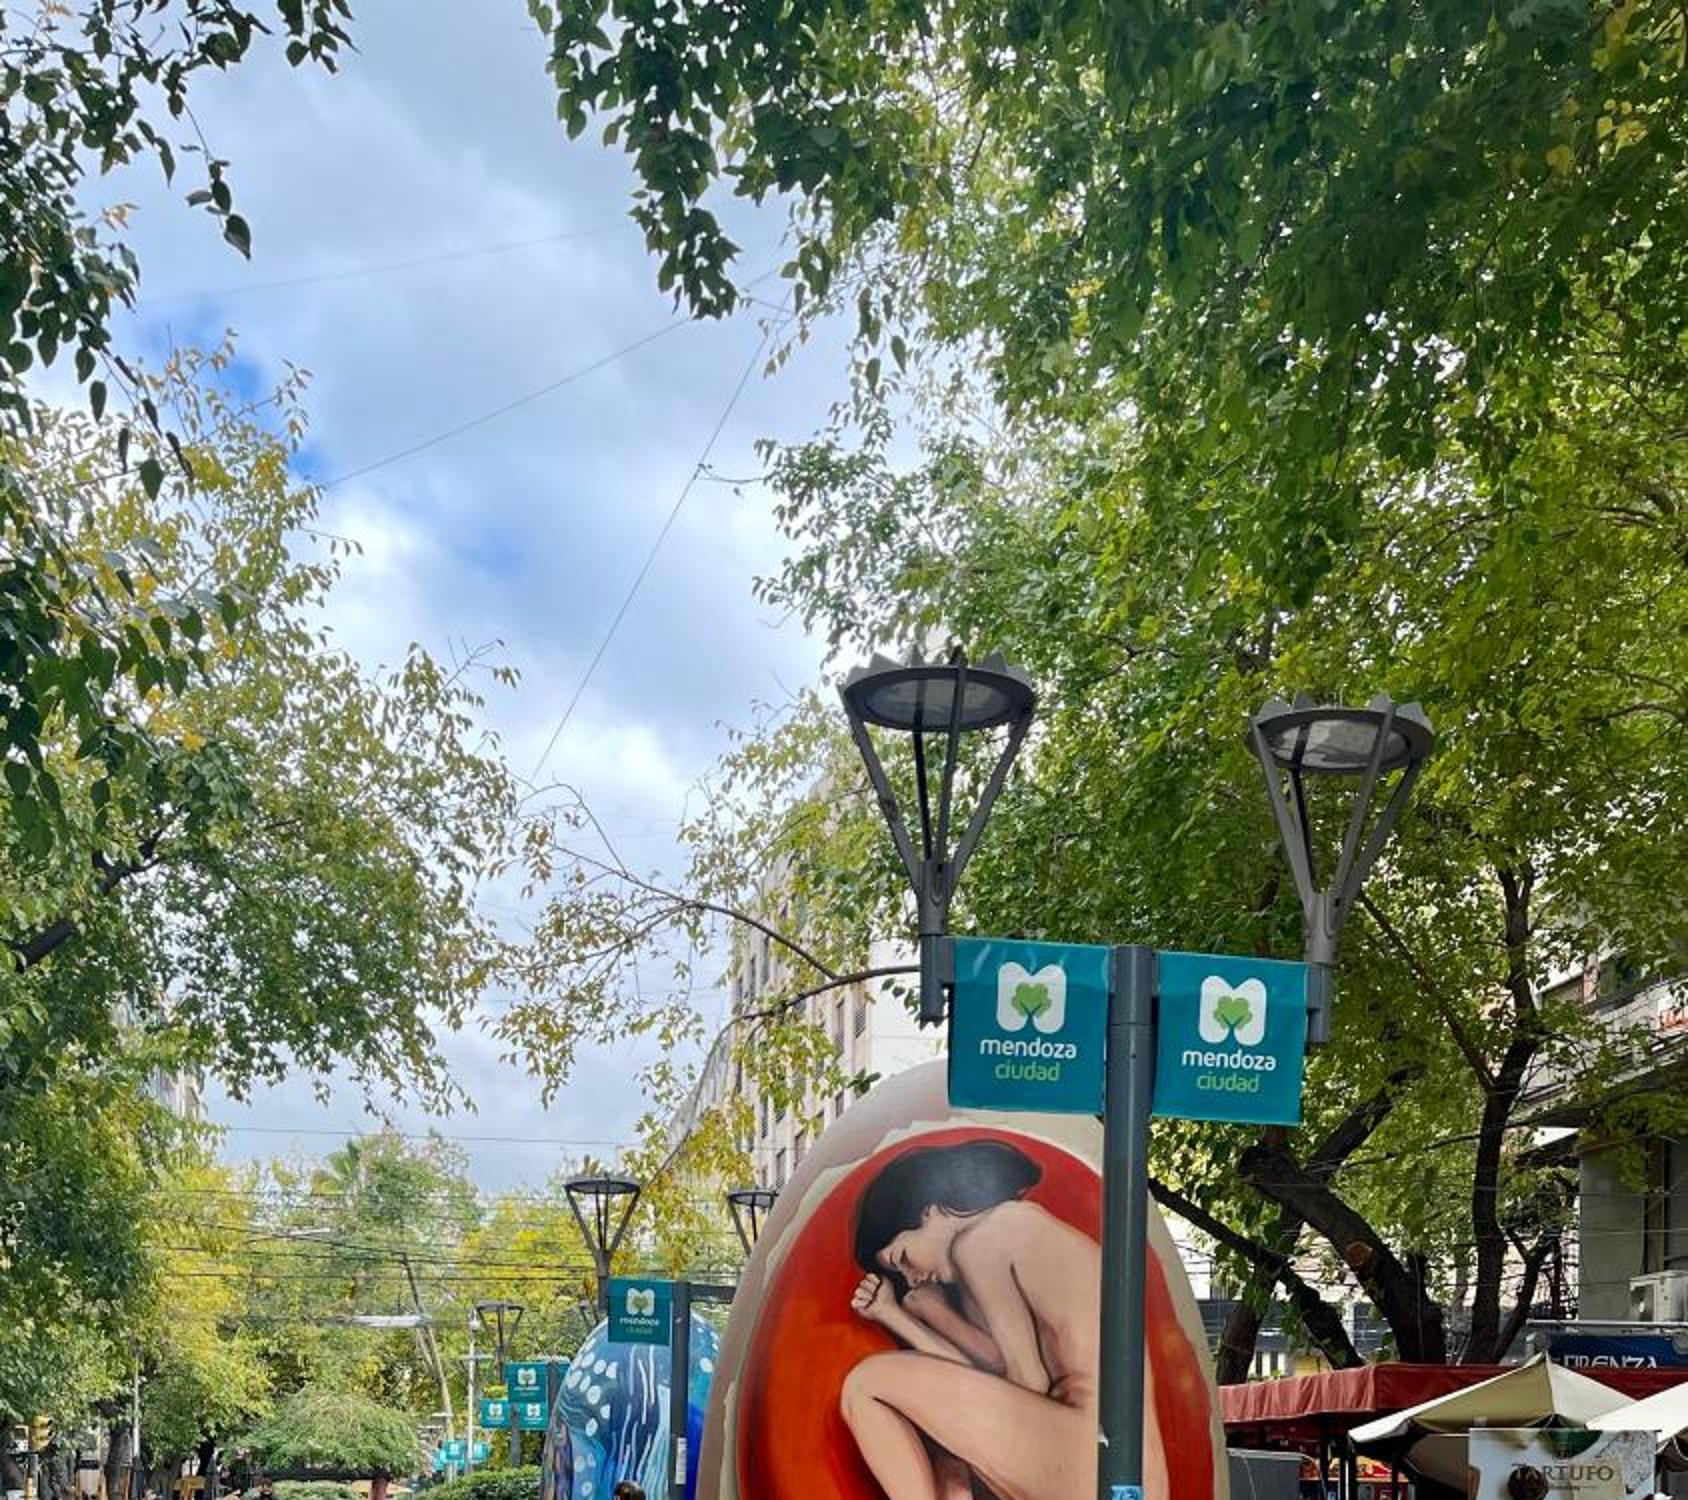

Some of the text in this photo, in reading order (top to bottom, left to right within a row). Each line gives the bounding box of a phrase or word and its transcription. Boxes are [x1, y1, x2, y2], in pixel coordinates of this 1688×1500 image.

[980, 1037, 1077, 1059] mendoza
[995, 1060, 1060, 1081] ciudad
[1182, 1048, 1277, 1071] mendoza
[1197, 1071, 1260, 1093] ciudad
[1512, 1463, 1615, 1481] TARTUFO
